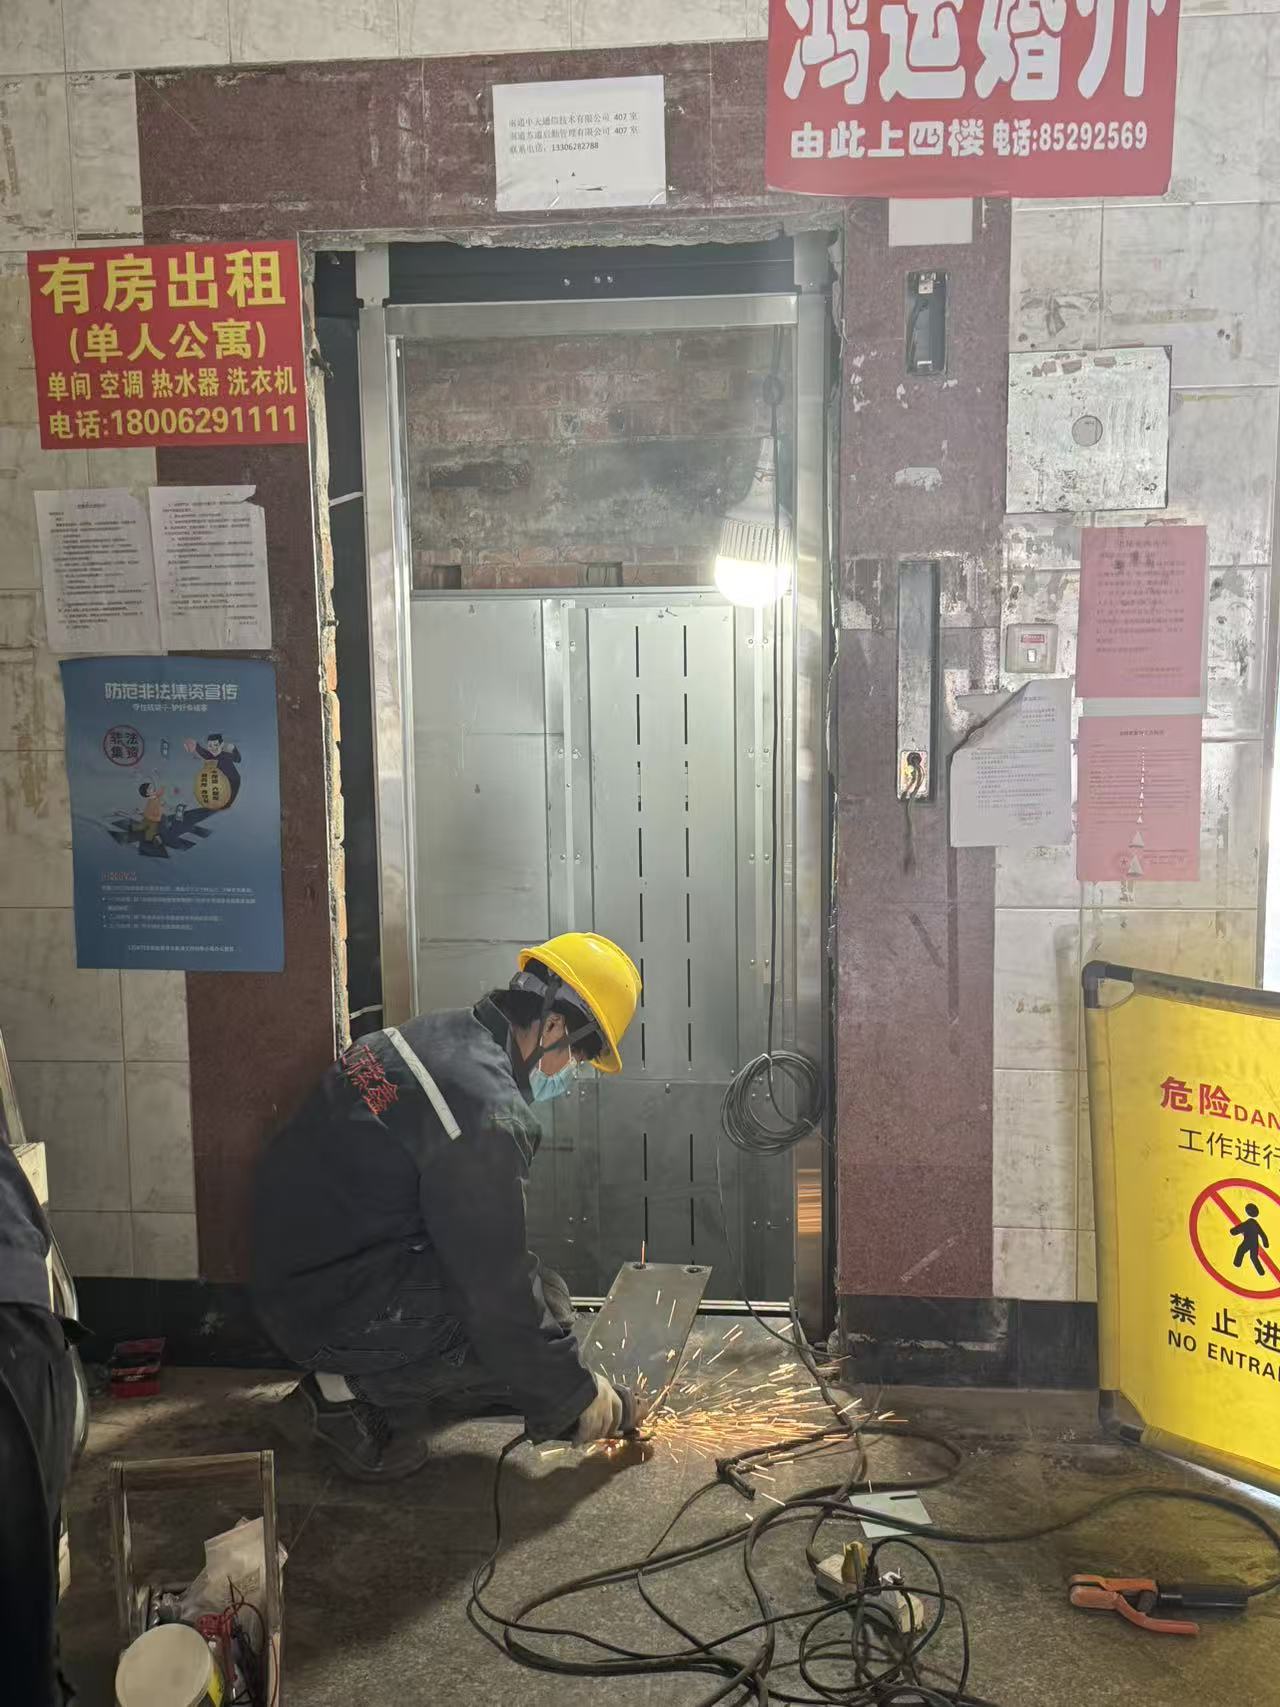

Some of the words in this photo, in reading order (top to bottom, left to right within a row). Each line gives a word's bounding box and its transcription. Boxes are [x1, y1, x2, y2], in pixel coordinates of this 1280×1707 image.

[783, 0, 1166, 104] 鸿运婚介
[614, 113, 627, 121] 407
[552, 142, 599, 152] 13306282788
[790, 119, 985, 159] 由此上四楼
[992, 118, 1148, 156] 电话:85292569
[38, 249, 286, 314] 有房出租
[69, 318, 266, 364] (单人公寓)
[48, 371, 91, 401] 单间
[99, 370, 144, 399] 空调
[151, 367, 220, 398] 热水器
[227, 365, 297, 396] 洗衣机
[48, 404, 296, 439] 电话:18006291111
[104, 683, 239, 700] 防范非法集资宣传
[1160, 1076, 1231, 1119] 危险
[1170, 1293, 1280, 1354] 禁止进
[1168, 1329, 1197, 1352] NO
[1208, 1342, 1280, 1382] ENTRA
